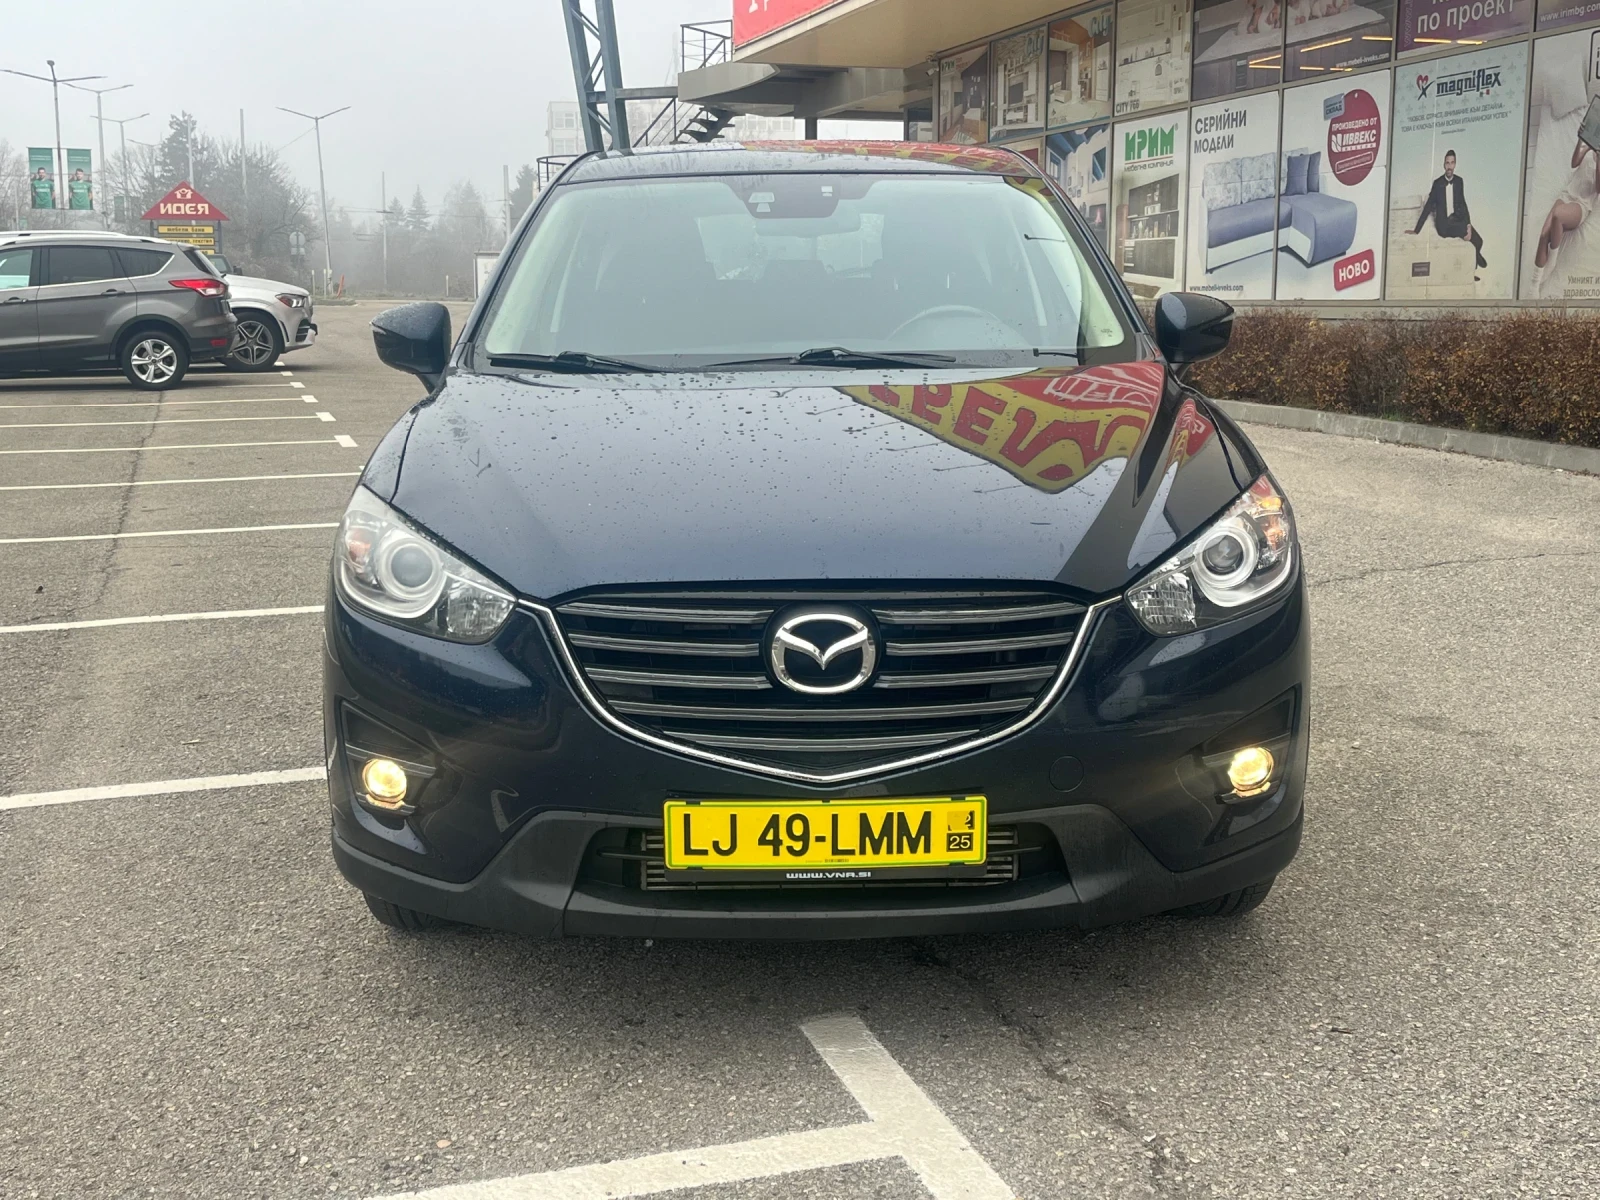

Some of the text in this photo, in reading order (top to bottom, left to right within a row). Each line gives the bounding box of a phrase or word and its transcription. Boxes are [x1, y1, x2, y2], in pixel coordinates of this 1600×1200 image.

[1417, 12, 1441, 33] по
[1447, 0, 1513, 30] проект
[1437, 69, 1502, 96] magniflex
[1195, 108, 1247, 135] СЕРИЙНИ
[1332, 117, 1378, 131] ПРОИЗВЕДЕНО ОТ
[1125, 125, 1174, 161] ИРИМ
[1194, 134, 1234, 154] МОДЕЛИ
[1343, 130, 1376, 145] ИВВЕКС
[1124, 160, 1174, 172] мебелна компания
[160, 203, 209, 214] ИДЕЯ
[1338, 259, 1370, 282] НОВО
[1568, 275, 1594, 285] Умният
[683, 810, 932, 857] LJ 49-LMM
[949, 835, 971, 849] 25
